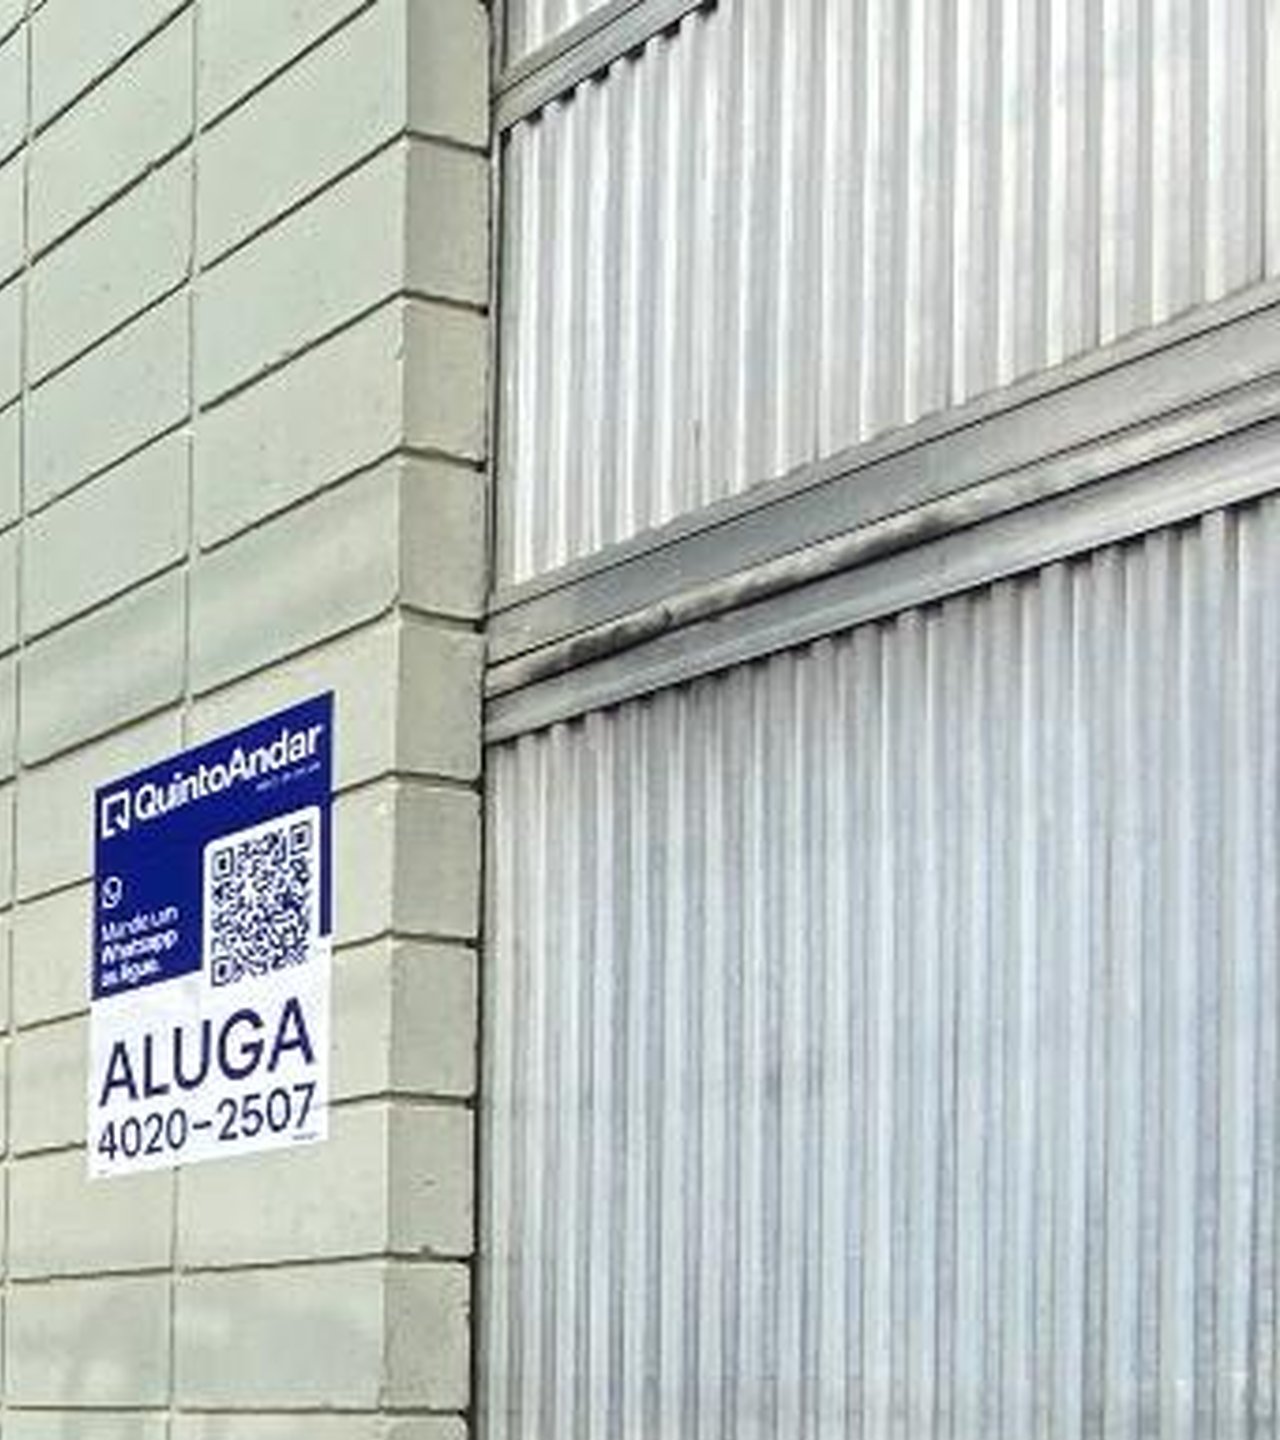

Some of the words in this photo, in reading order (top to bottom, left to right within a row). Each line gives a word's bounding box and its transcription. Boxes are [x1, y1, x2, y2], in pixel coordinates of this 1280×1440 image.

[134, 724, 324, 821] QuintoAndar
[98, 997, 315, 1107] ALUGA
[98, 1081, 317, 1161] 4020-2507
